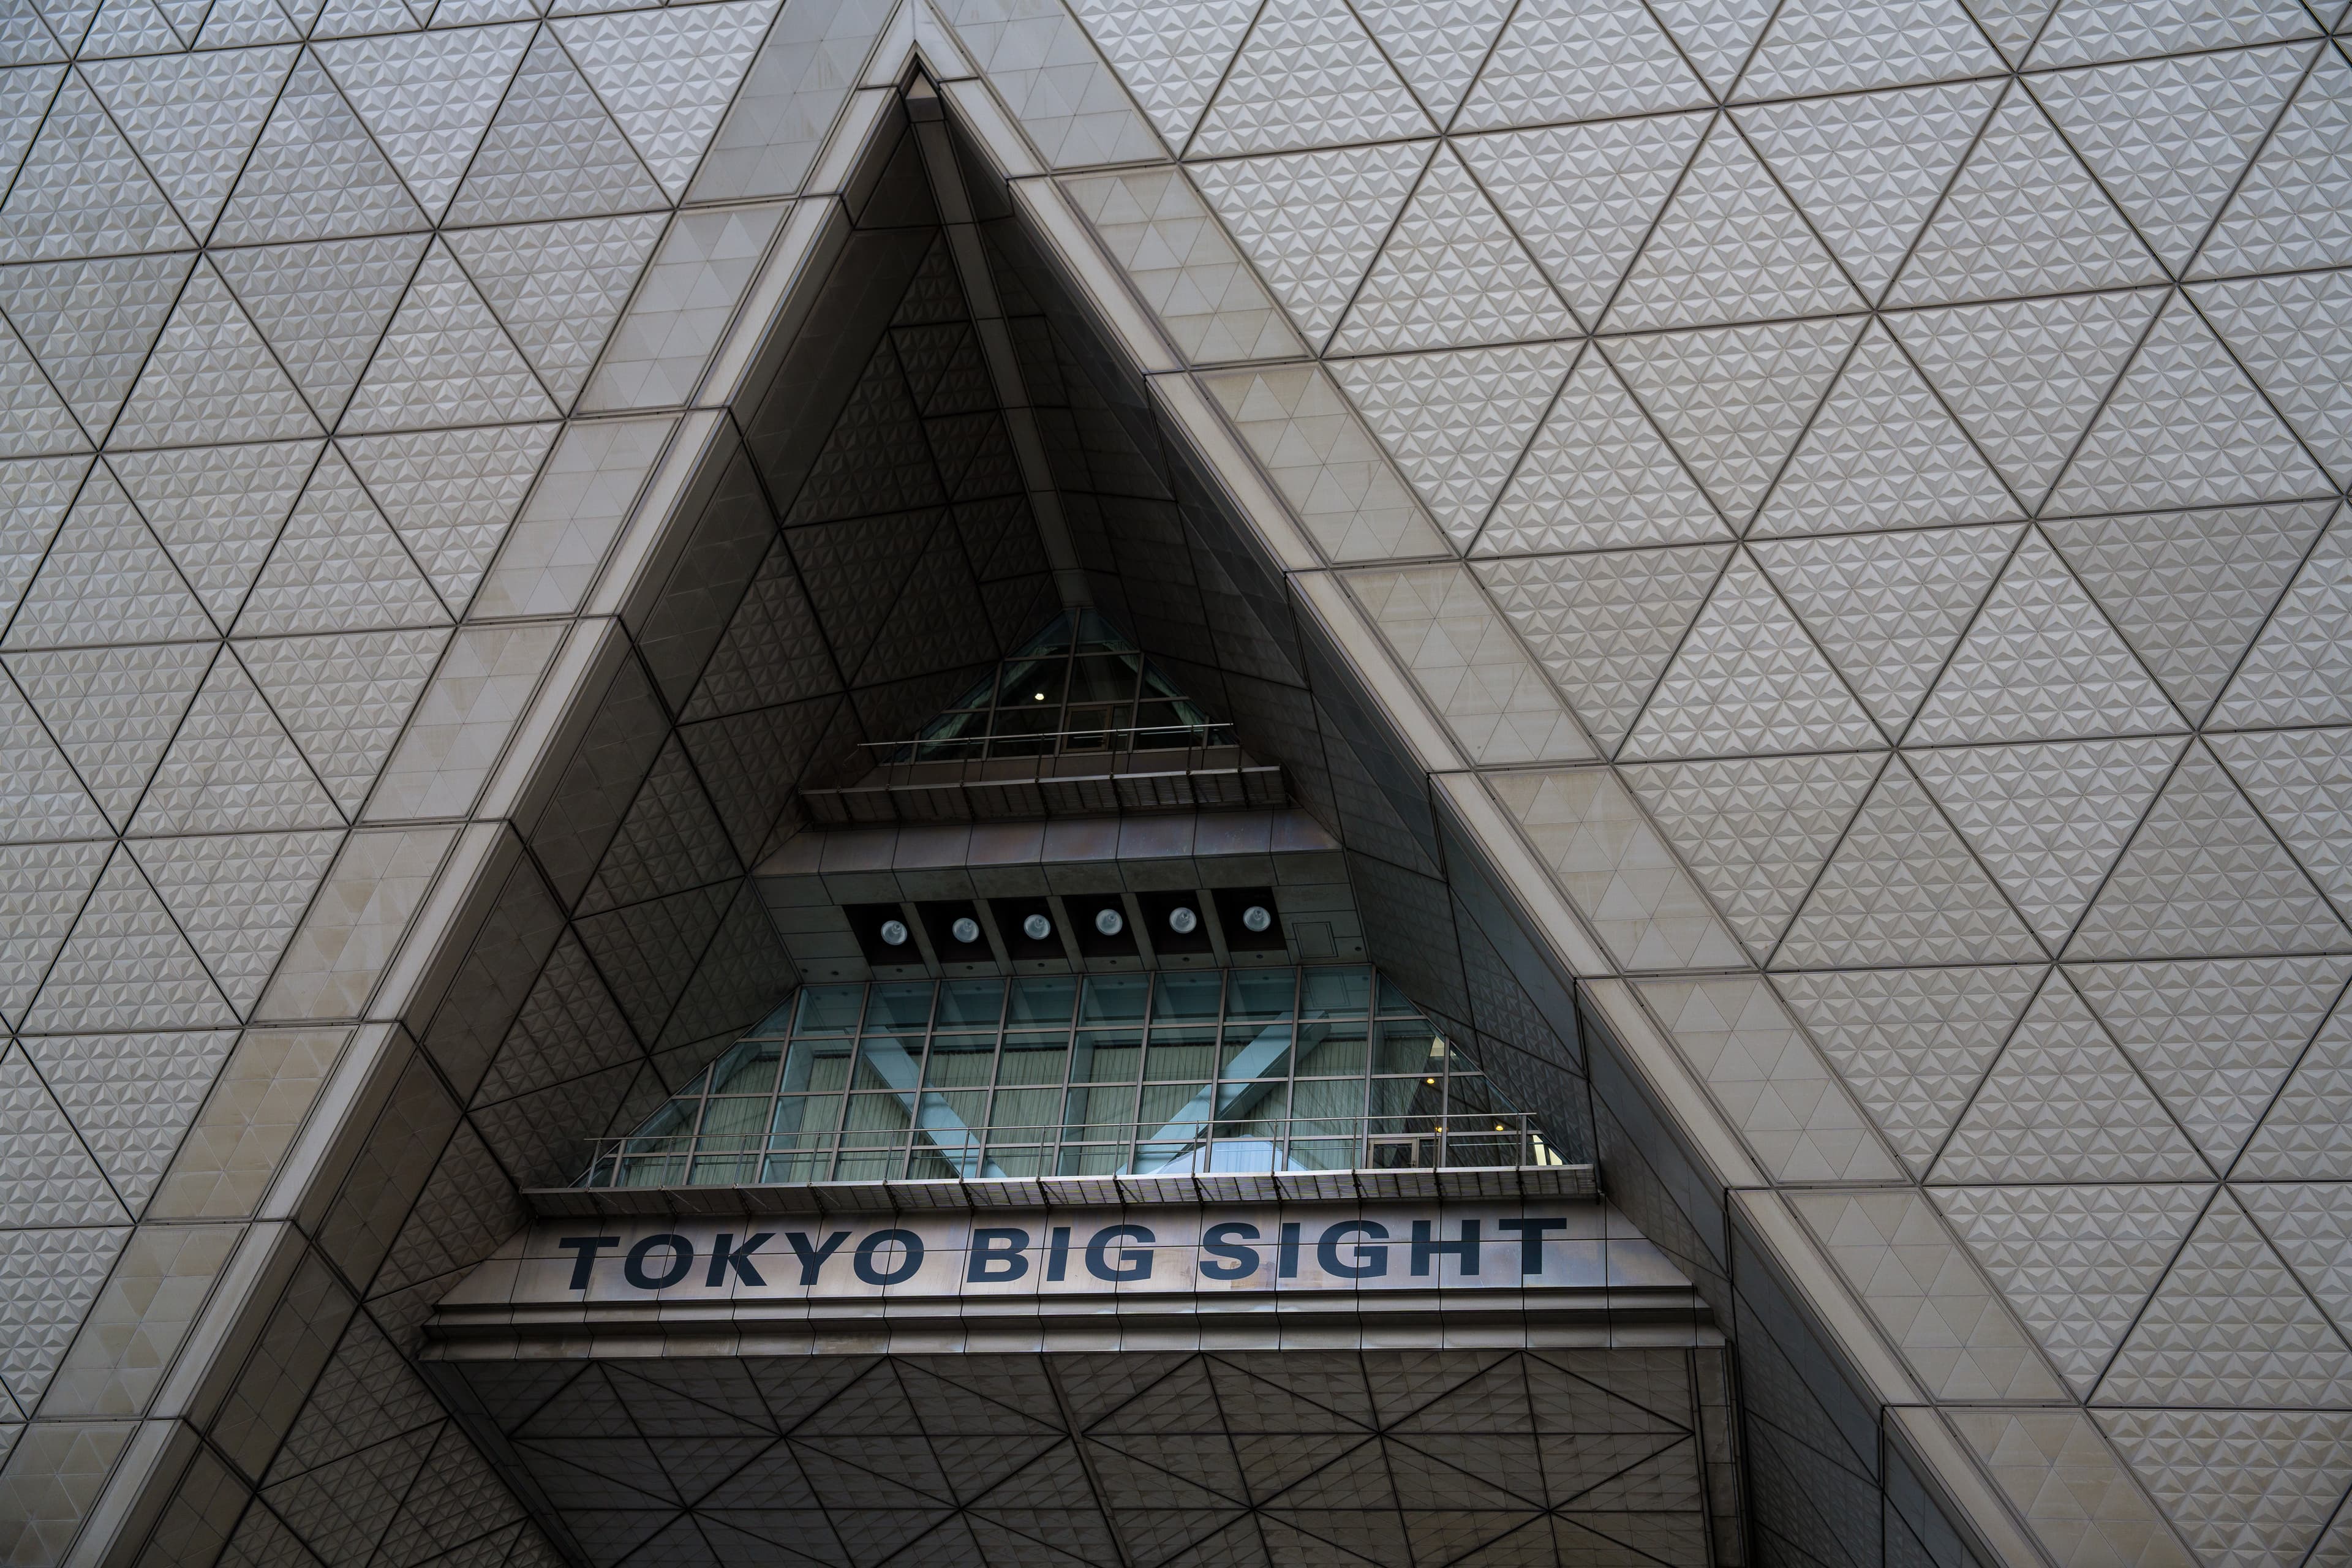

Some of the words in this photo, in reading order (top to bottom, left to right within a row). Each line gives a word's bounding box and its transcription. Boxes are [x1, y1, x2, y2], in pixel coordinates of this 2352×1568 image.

[559, 1229, 925, 1290] TOKYO
[966, 1225, 1156, 1283] BIG
[1199, 1218, 1567, 1280] SIGHT
